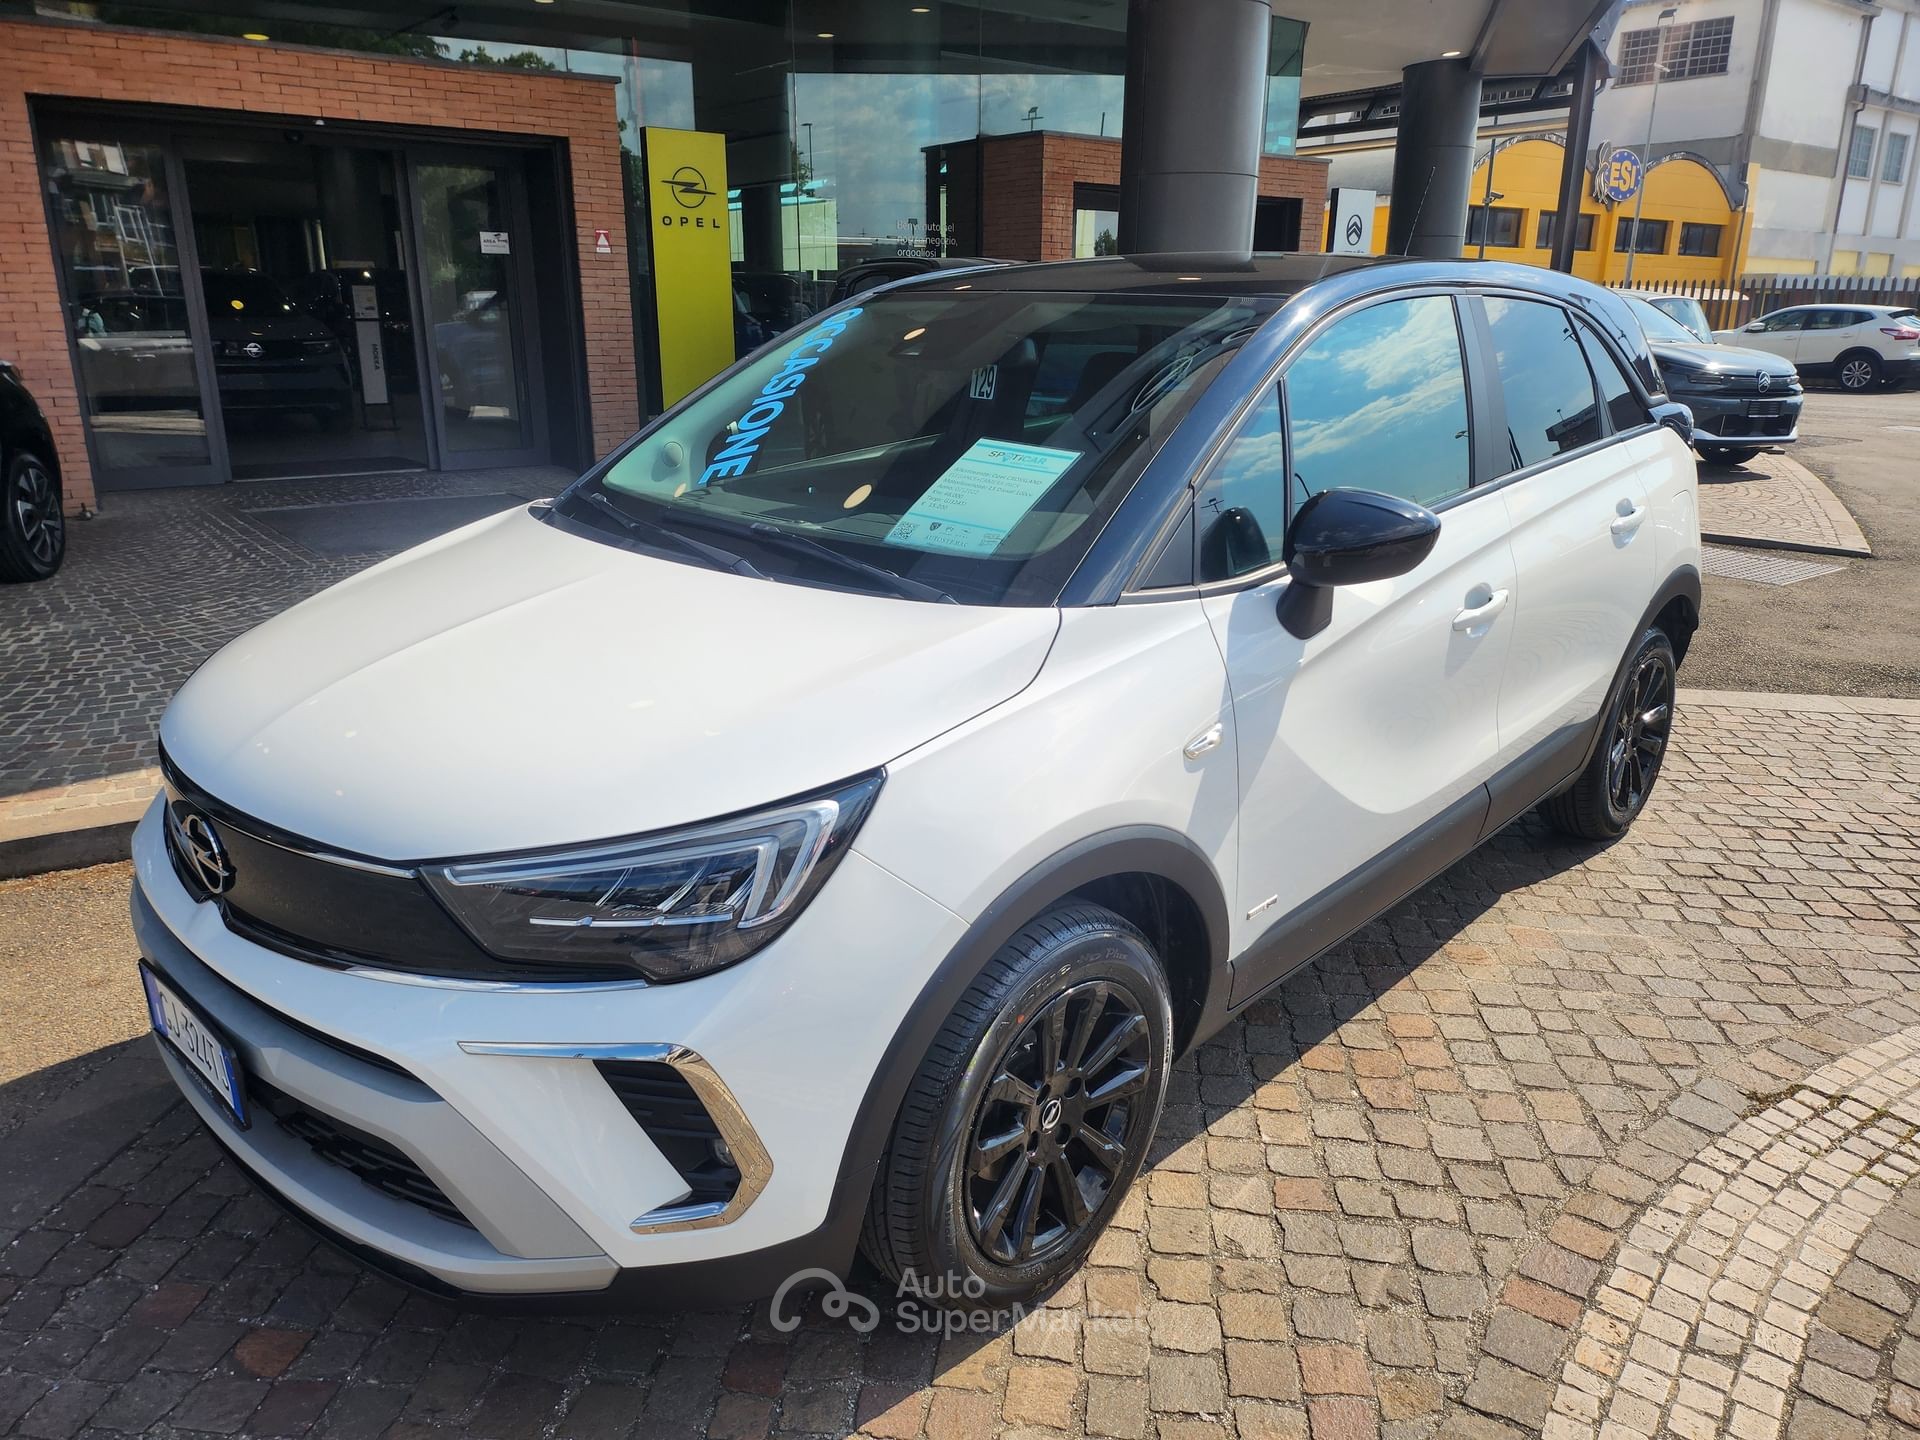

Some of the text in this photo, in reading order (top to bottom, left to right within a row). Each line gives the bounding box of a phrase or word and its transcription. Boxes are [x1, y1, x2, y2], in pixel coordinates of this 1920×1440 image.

[1609, 160, 1637, 192] ESI
[662, 215, 721, 229] OPEL
[698, 307, 864, 485] OCCASIONE
[973, 366, 995, 399] 129
